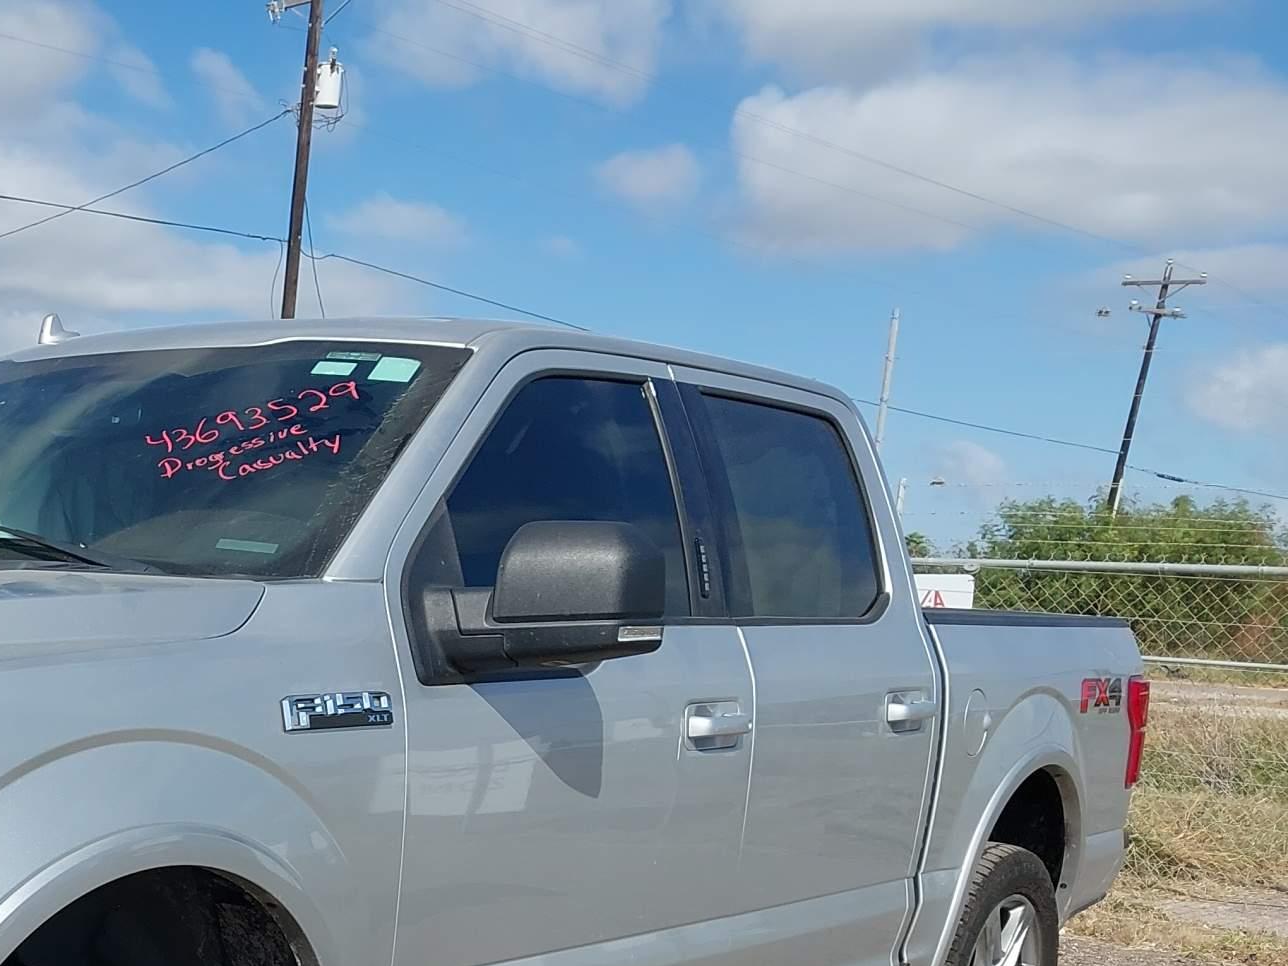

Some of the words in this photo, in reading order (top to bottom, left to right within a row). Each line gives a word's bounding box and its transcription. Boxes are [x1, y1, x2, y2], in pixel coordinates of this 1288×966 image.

[145, 381, 360, 453] 43693529
[218, 434, 341, 480] Casualty
[1080, 677, 1122, 714] FX4
[367, 713, 390, 723] XLT
